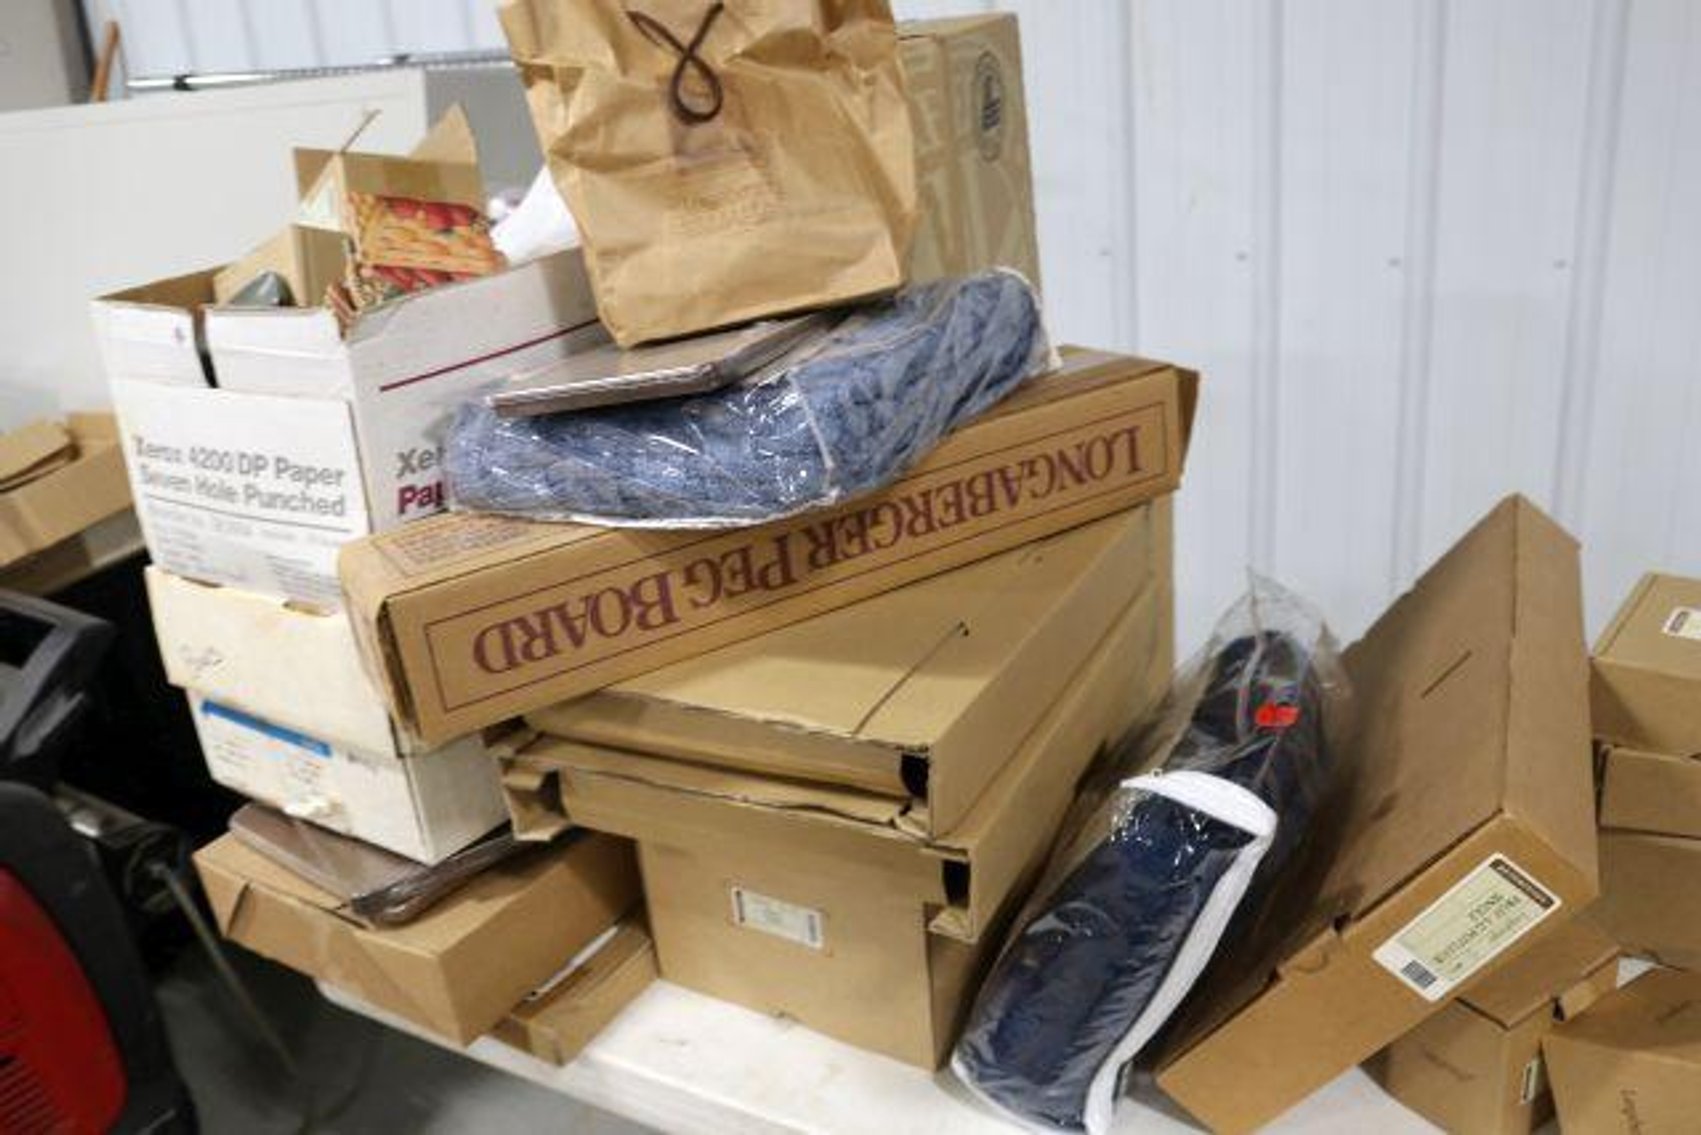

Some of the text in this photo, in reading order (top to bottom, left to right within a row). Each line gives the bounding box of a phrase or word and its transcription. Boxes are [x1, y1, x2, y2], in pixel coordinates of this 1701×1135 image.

[189, 446, 235, 474] 4200
[238, 453, 270, 478] DP
[274, 456, 345, 490] Paper
[194, 476, 239, 502] Hole
[243, 484, 345, 517] Punched
[472, 425, 1142, 674] LONGABERGER PEG BOARD
